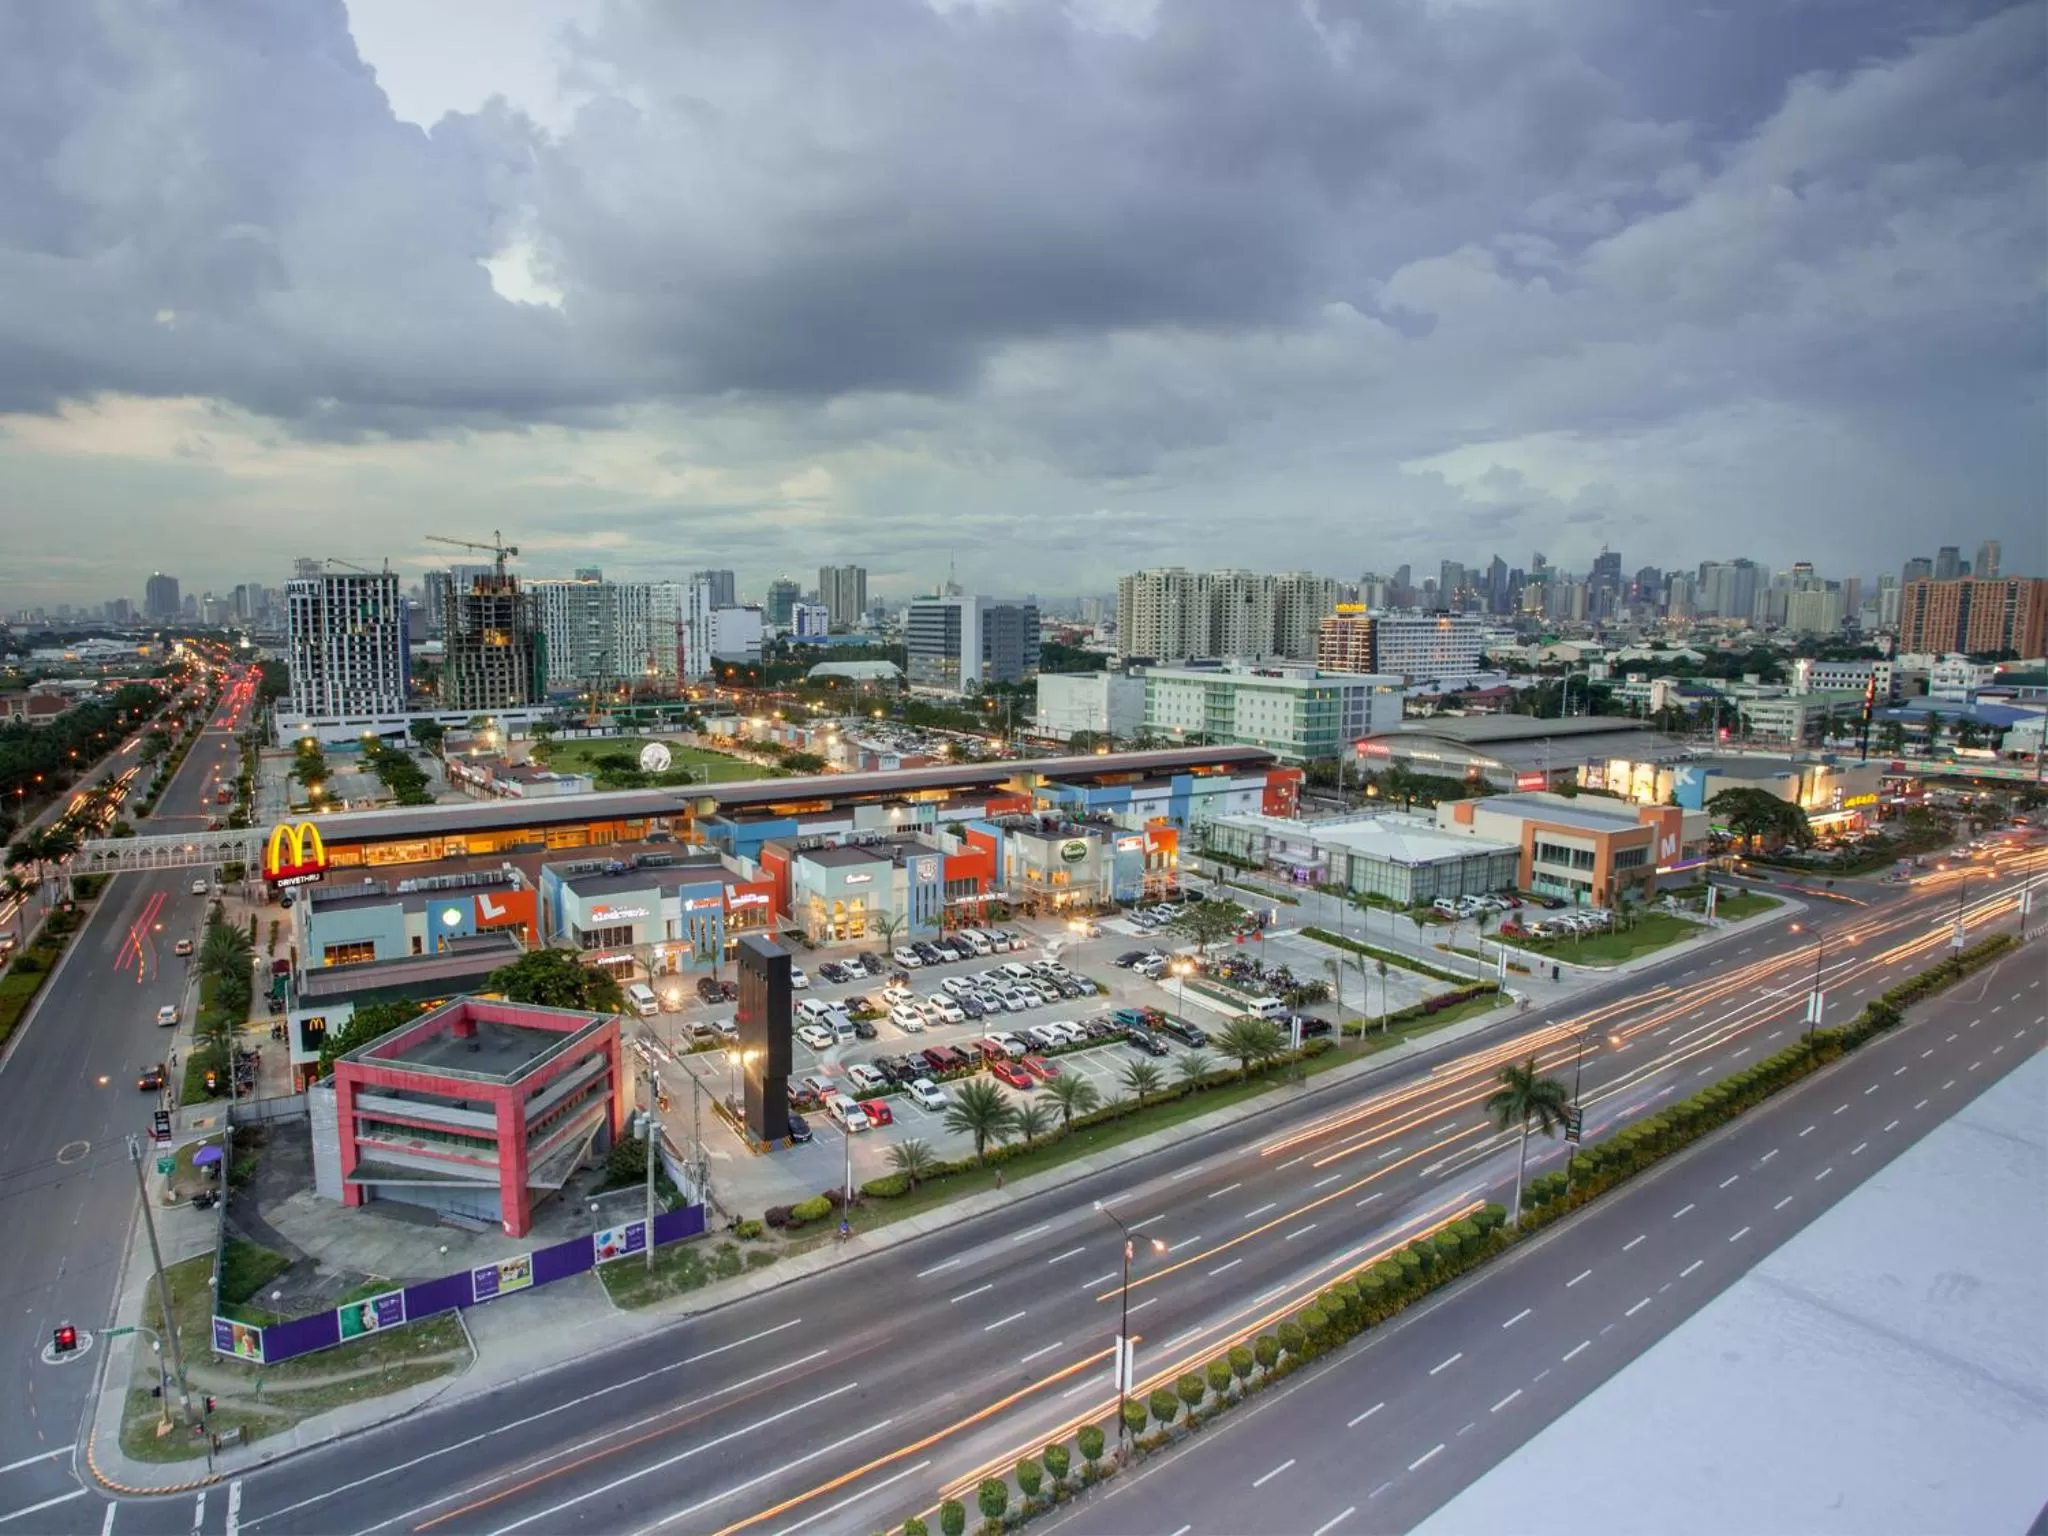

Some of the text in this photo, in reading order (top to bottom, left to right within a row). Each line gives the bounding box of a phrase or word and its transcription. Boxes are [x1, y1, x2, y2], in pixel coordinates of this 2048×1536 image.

[1661, 833, 1676, 860] M
[277, 873, 320, 887] DRIVETHRU
[478, 894, 506, 920] L
